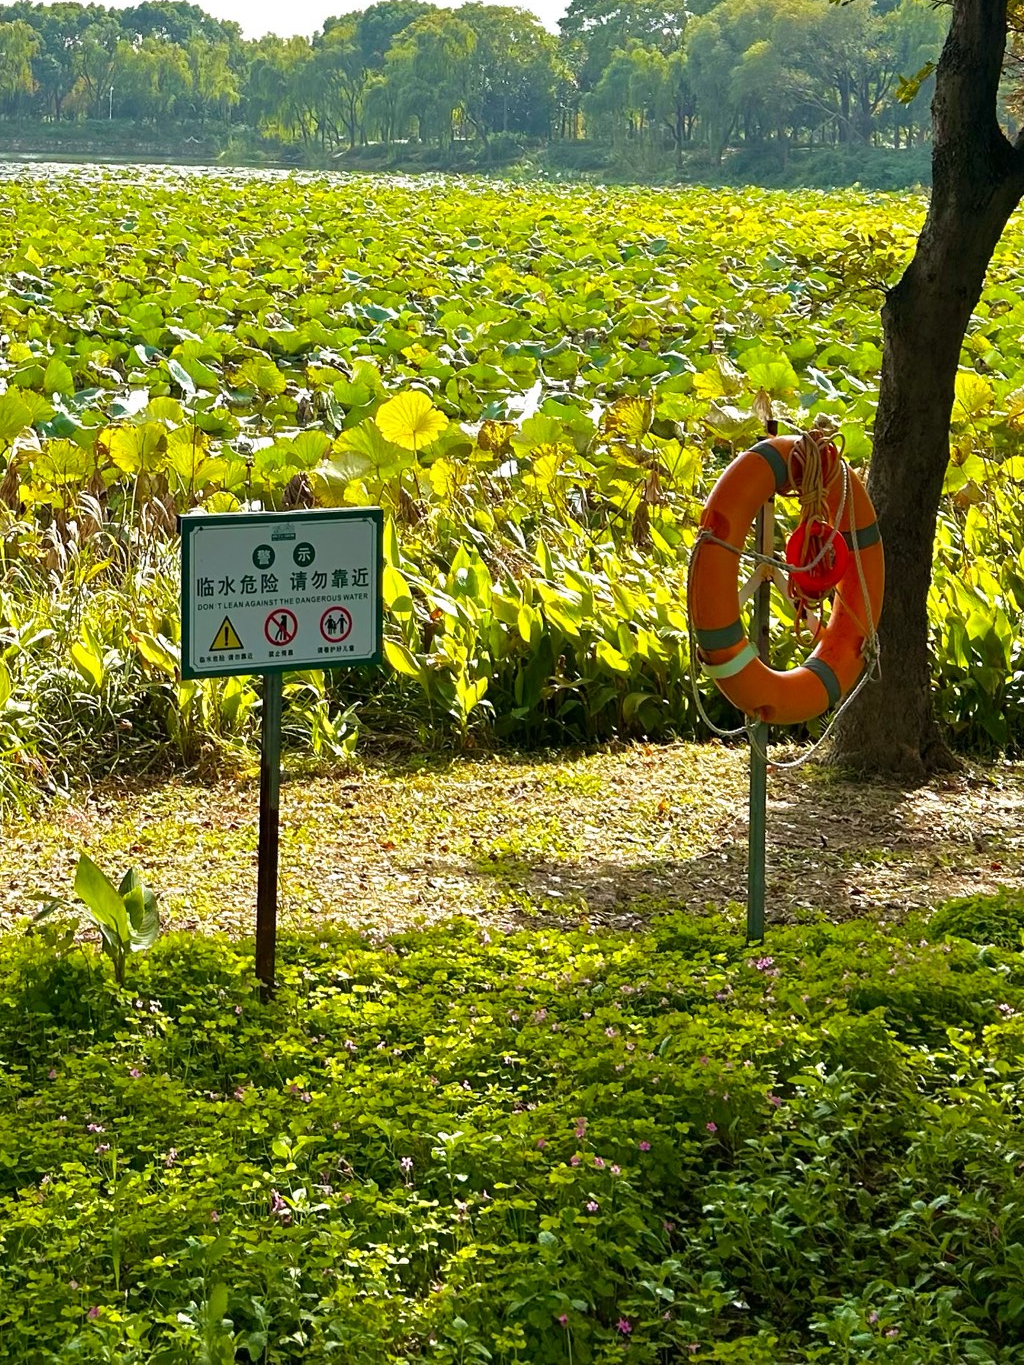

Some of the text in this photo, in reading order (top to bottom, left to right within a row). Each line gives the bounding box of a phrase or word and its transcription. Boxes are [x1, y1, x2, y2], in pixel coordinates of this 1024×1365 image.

[197, 567, 369, 597] 临水危险 请勿靠近
[224, 601, 243, 609] LEAN
[245, 599, 278, 607] AGAINST
[296, 594, 342, 604] DANGEROUS
[343, 593, 368, 601] WATER
